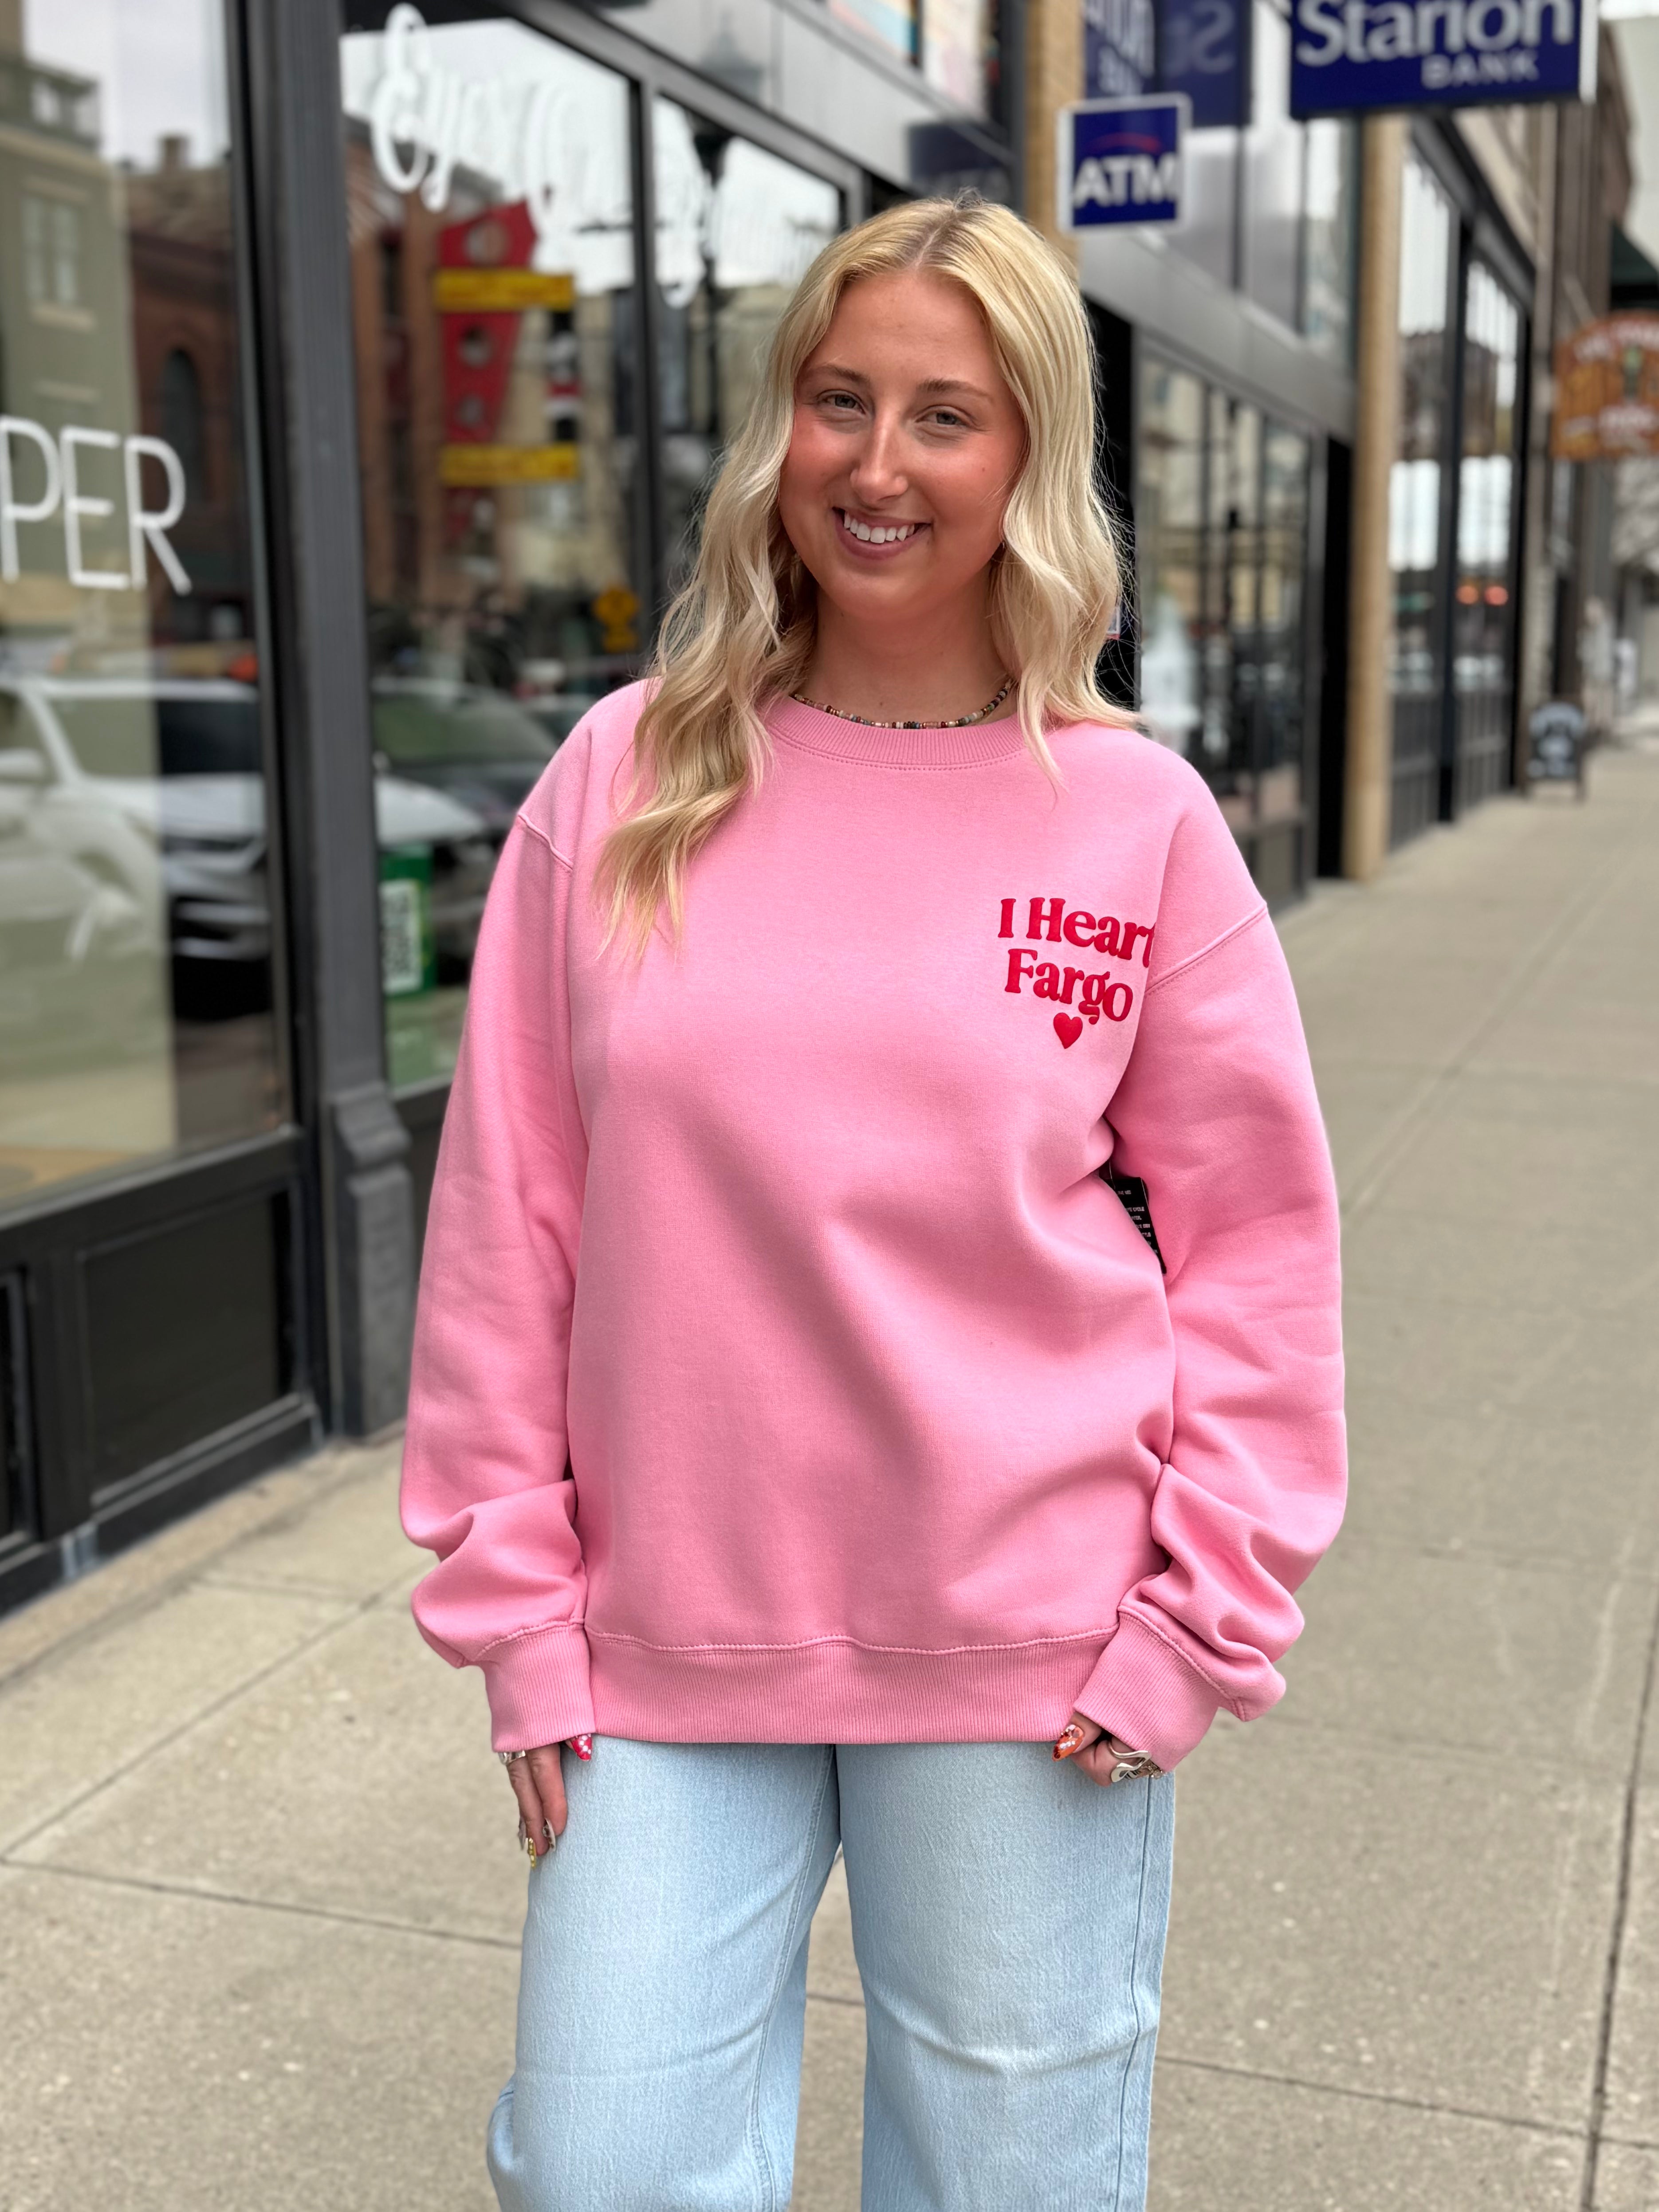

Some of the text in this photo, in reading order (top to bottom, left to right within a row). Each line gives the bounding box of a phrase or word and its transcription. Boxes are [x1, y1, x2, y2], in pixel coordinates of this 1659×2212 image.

[1421, 49, 1540, 89] BANK
[1073, 152, 1178, 208] ATM
[0, 415, 193, 597] PER
[998, 897, 1156, 968] I Heart
[1005, 948, 1133, 1025] Fargo
